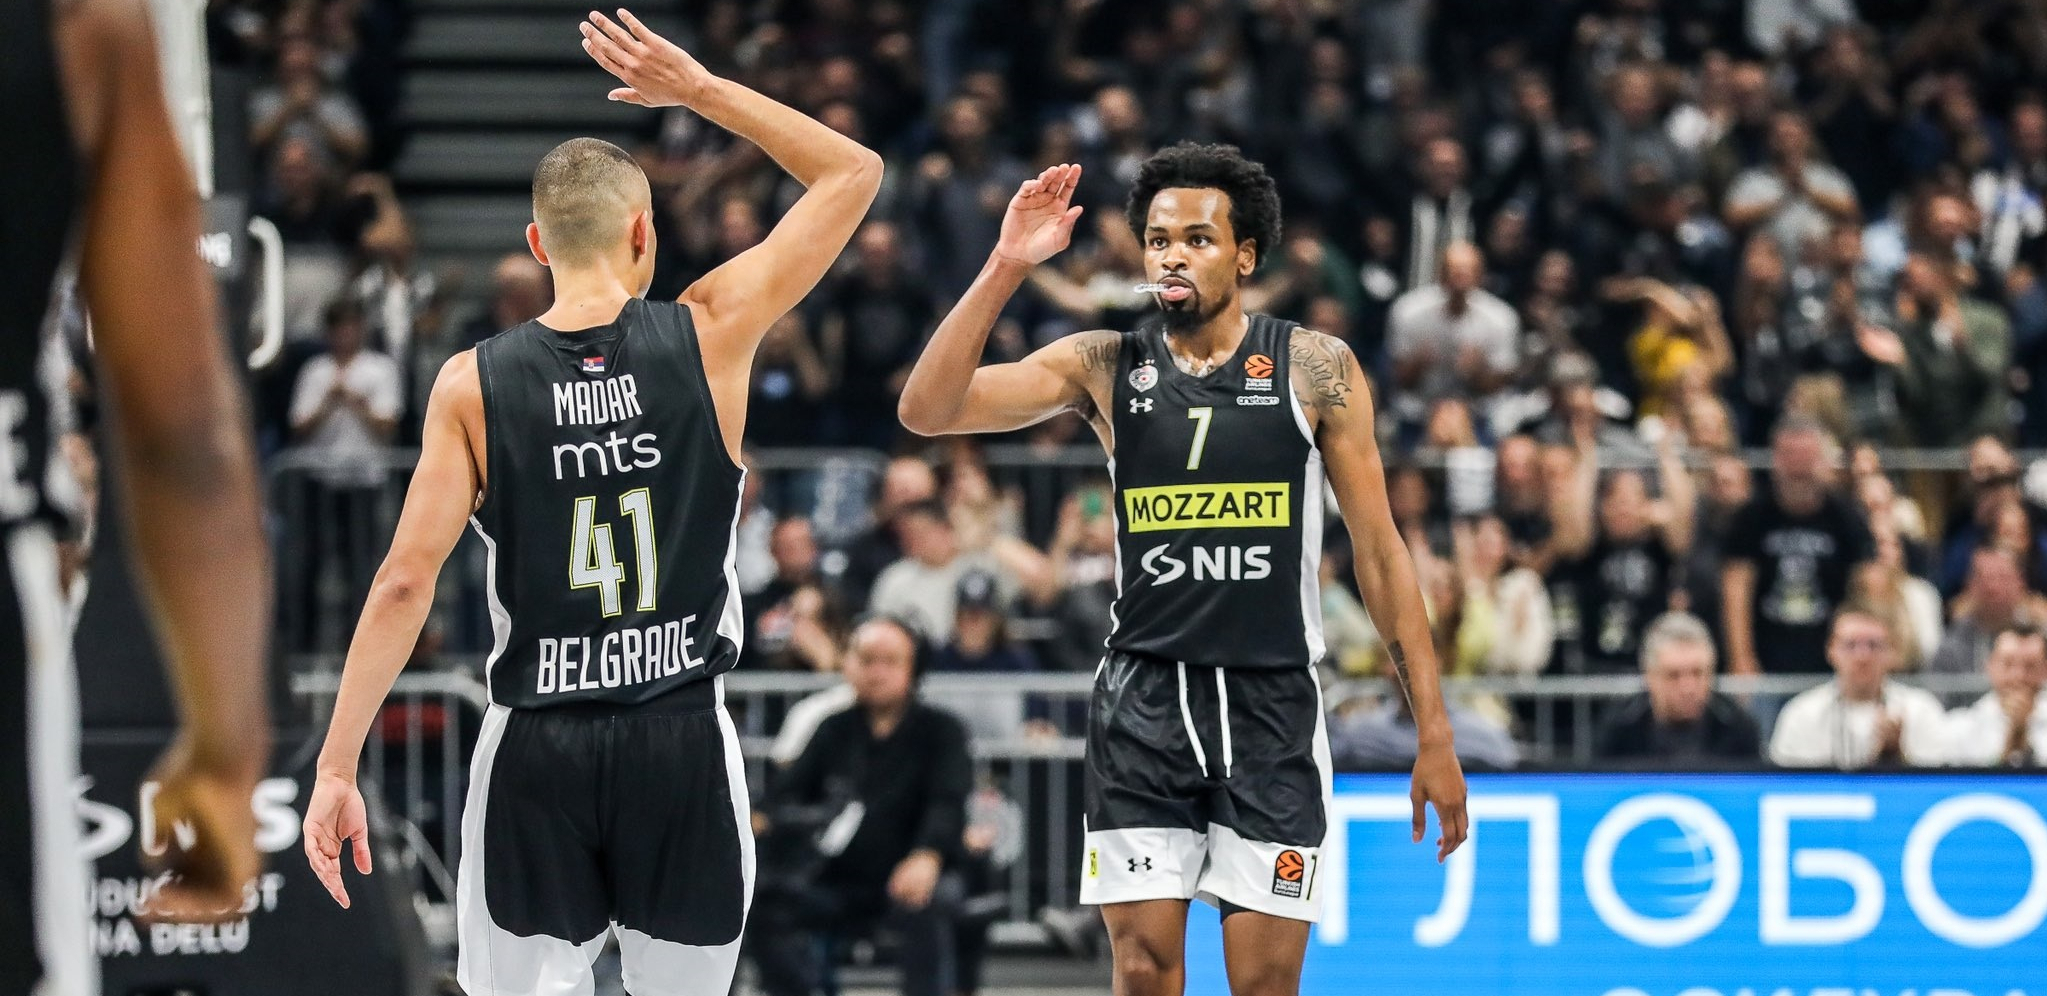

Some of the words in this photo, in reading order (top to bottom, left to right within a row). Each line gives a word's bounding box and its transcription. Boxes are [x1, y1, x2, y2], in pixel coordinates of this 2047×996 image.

[552, 373, 643, 426] MADAR
[552, 430, 662, 480] mts
[1186, 407, 1213, 470] 7
[1131, 491, 1284, 523] MOZZART
[568, 487, 657, 618] 41
[1192, 545, 1272, 581] NIS
[536, 614, 705, 694] BELGRADE
